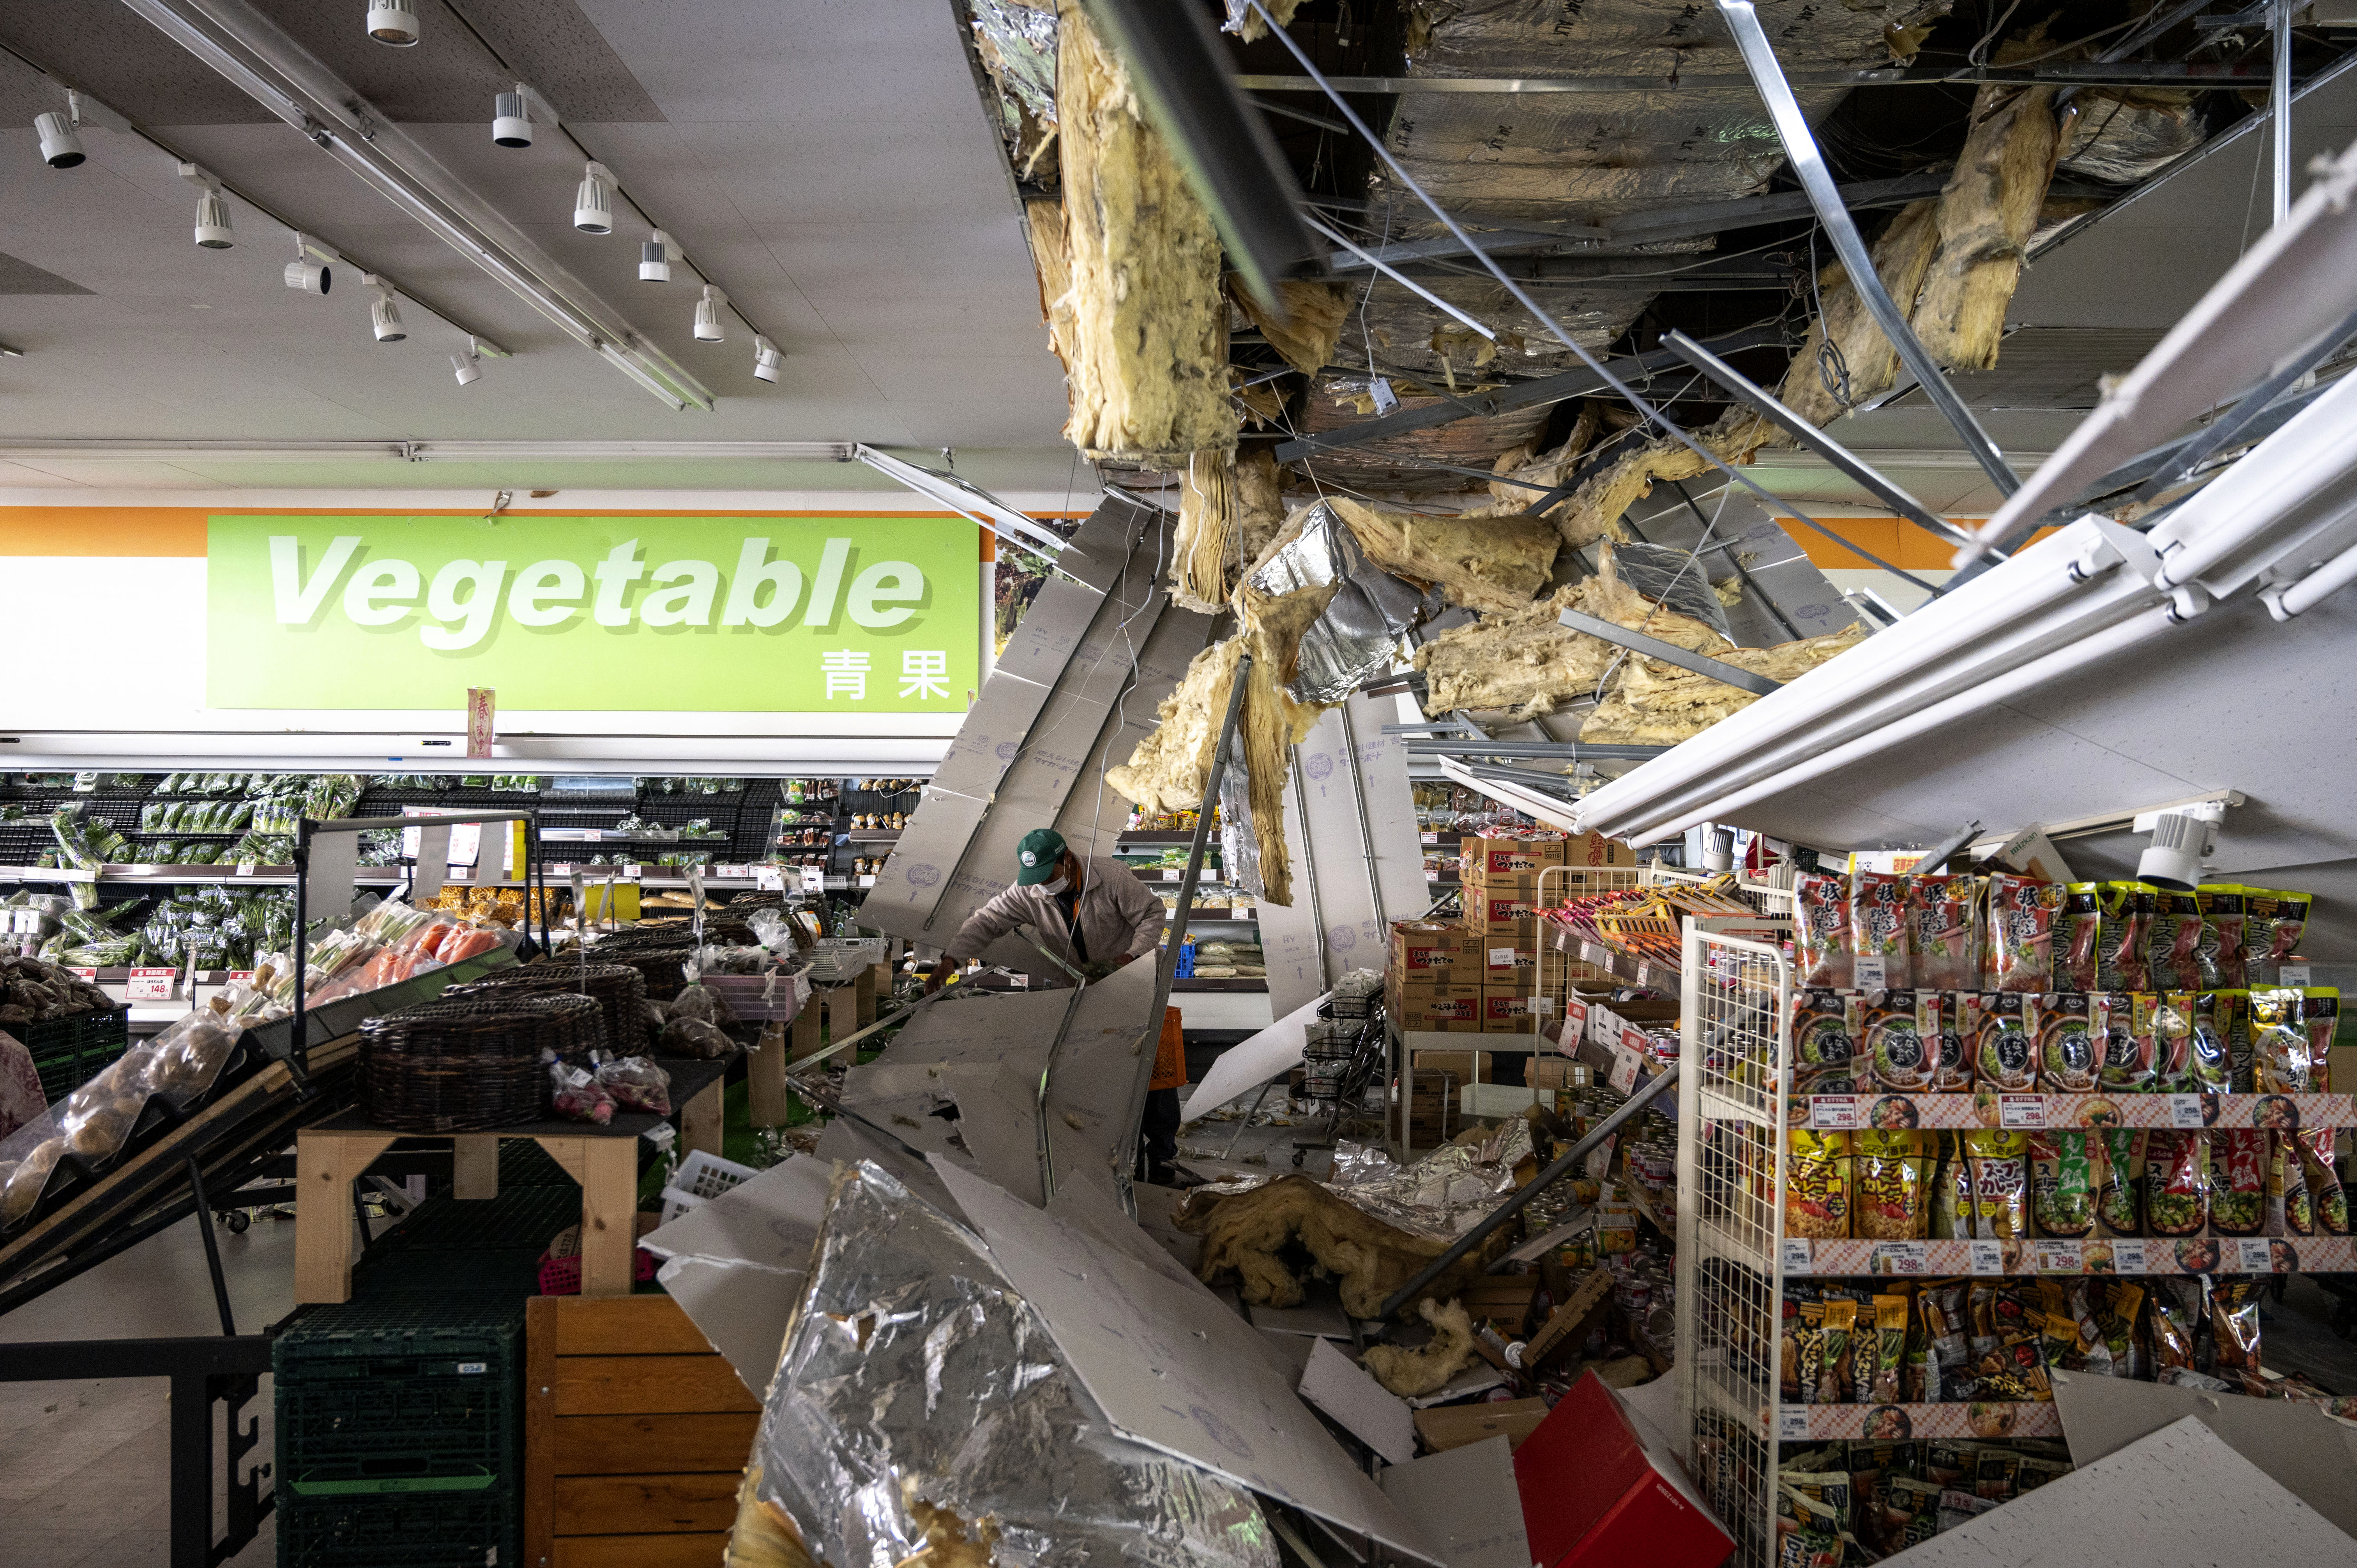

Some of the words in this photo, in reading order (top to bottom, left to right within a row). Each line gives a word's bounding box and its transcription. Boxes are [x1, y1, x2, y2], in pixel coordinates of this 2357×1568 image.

[269, 537, 924, 650] Vegetable
[821, 650, 950, 700] 青果
[2009, 832, 2039, 855] mizkan
[2151, 918, 2175, 968] エスニック
[1495, 1006, 1530, 1015] つきたて
[1983, 1161, 2019, 1176] スープ
[2061, 1134, 2090, 1190] もつ鍋
[1878, 1194, 1903, 1204] スープ
